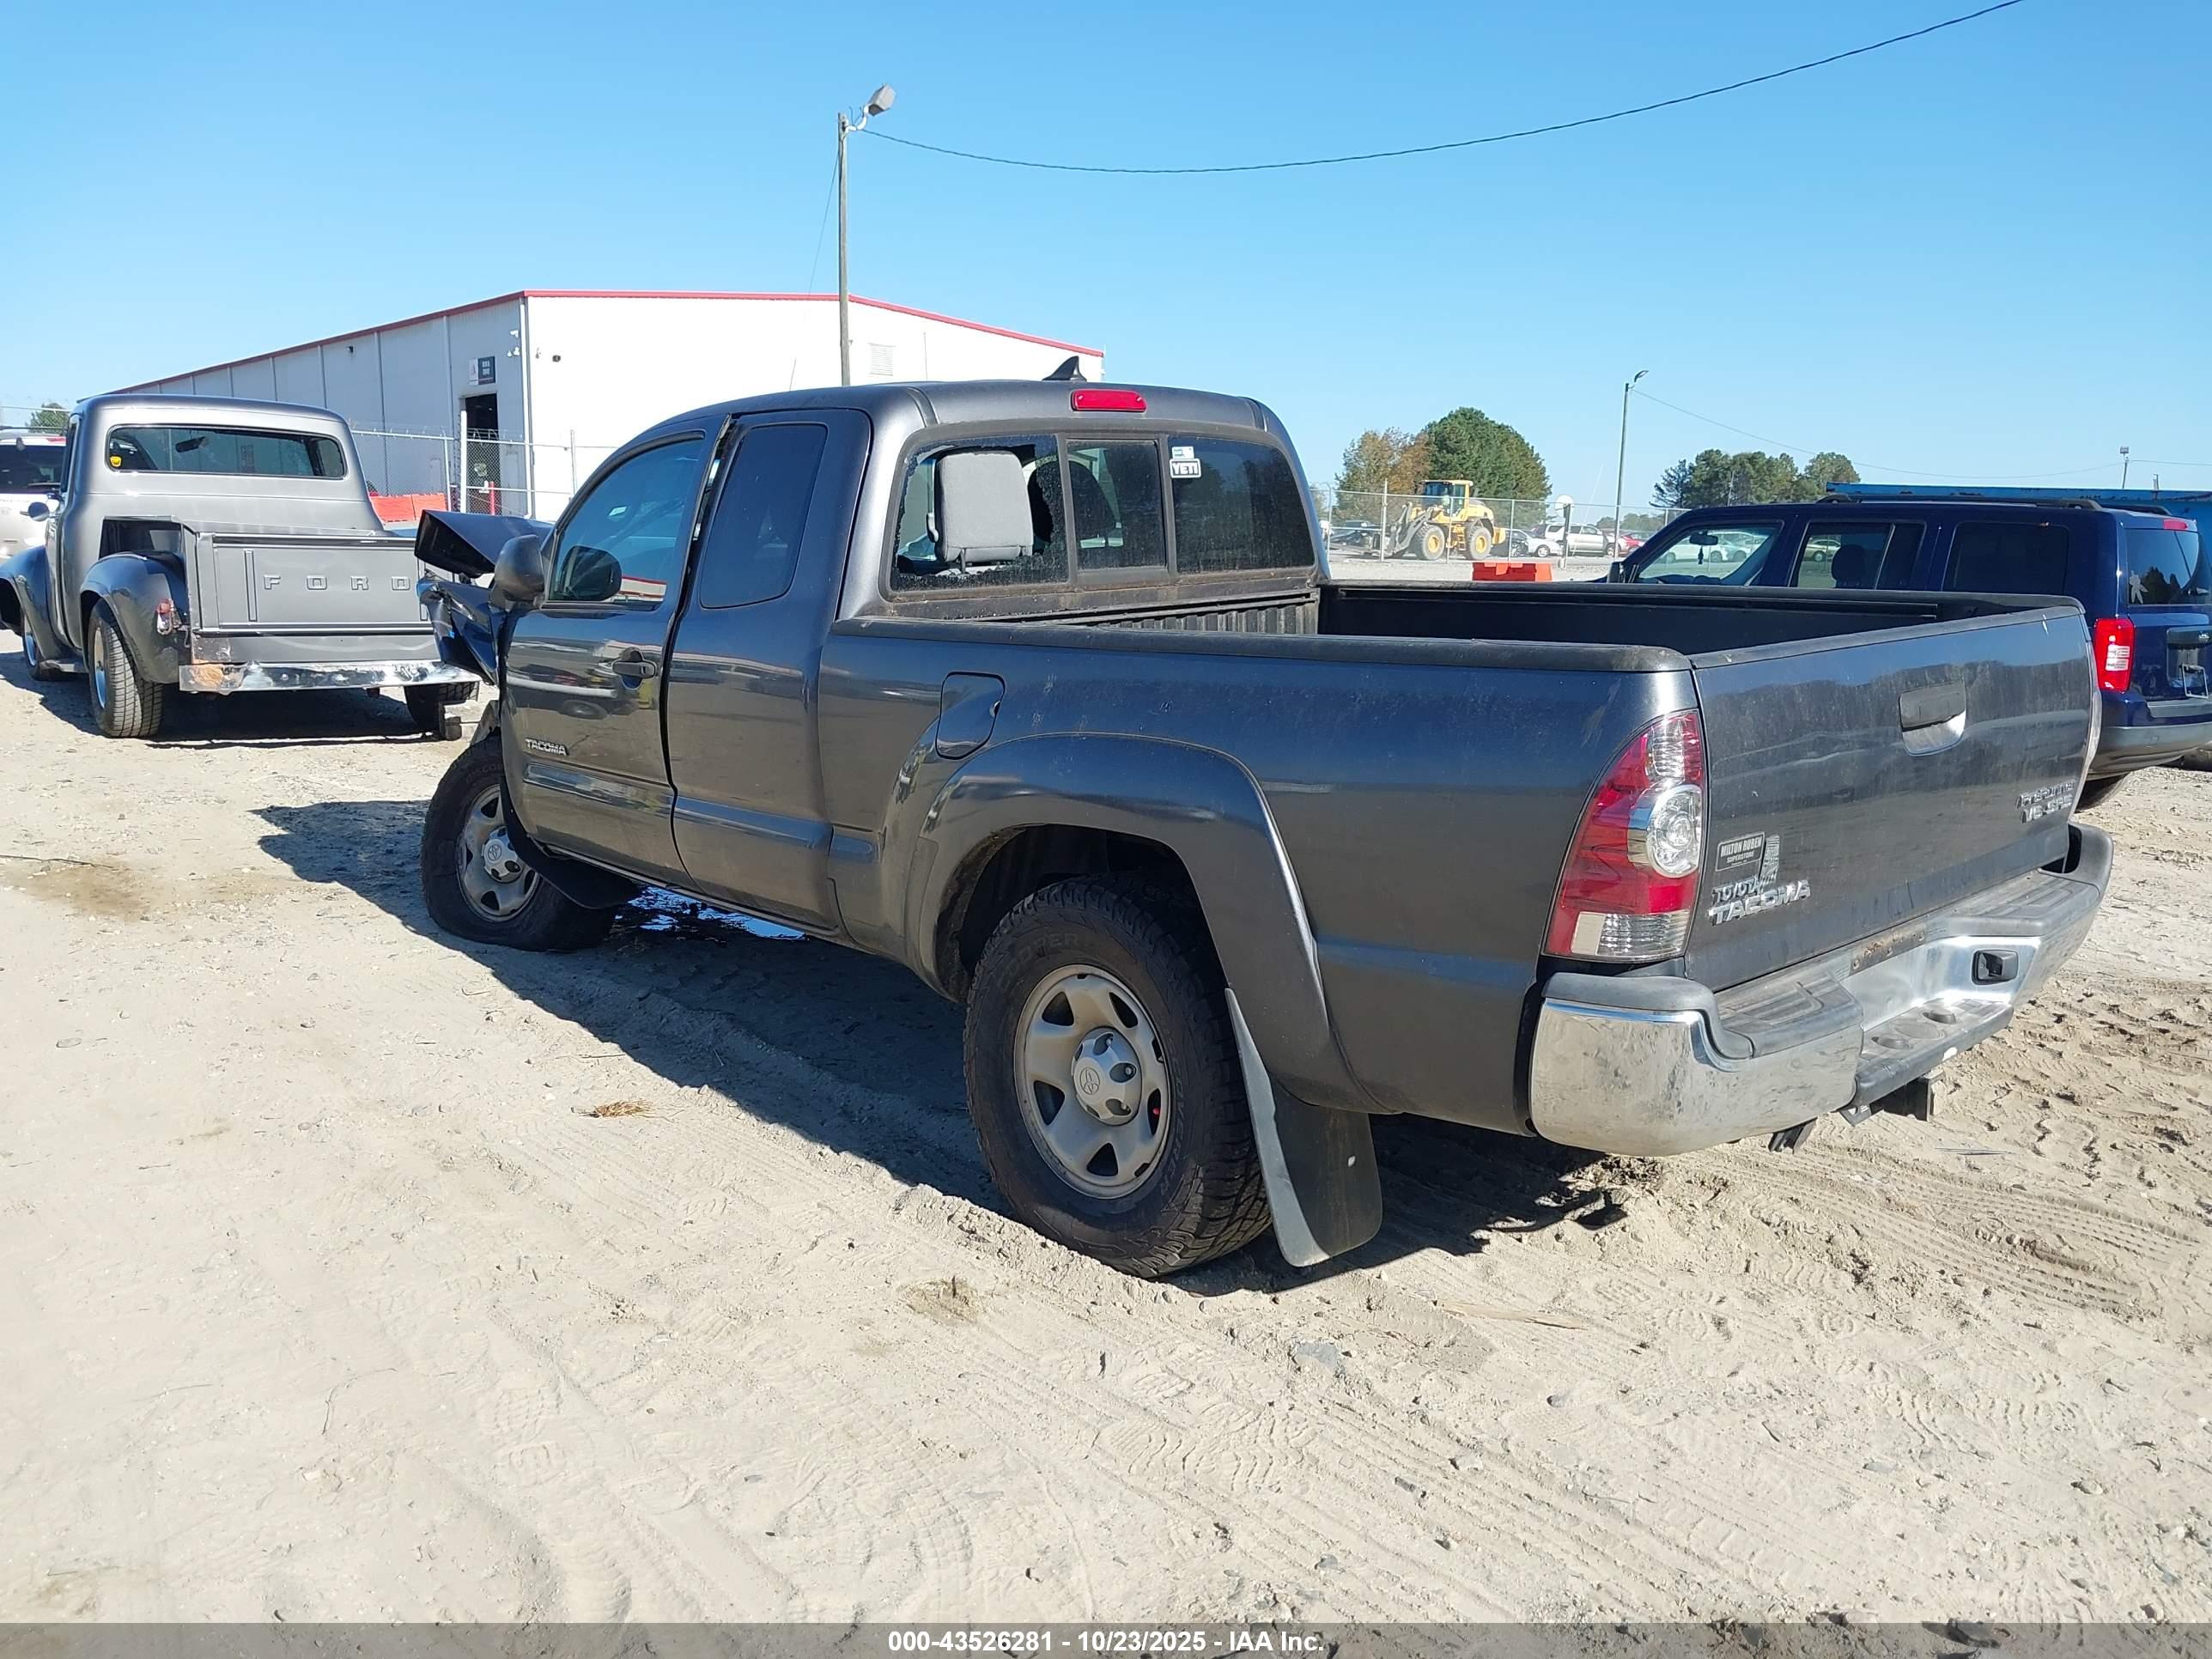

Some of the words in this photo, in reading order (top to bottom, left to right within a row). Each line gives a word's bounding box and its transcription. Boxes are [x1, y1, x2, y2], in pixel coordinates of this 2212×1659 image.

[1171, 461, 1199, 475] YETI
[264, 574, 410, 591] FORD
[525, 738, 568, 757] TACOMA
[1720, 841, 1743, 858] MILTON
[1743, 836, 1763, 851] RUBEN
[1711, 876, 1761, 904] TOYOTA
[1708, 880, 1811, 926] TACOMA
